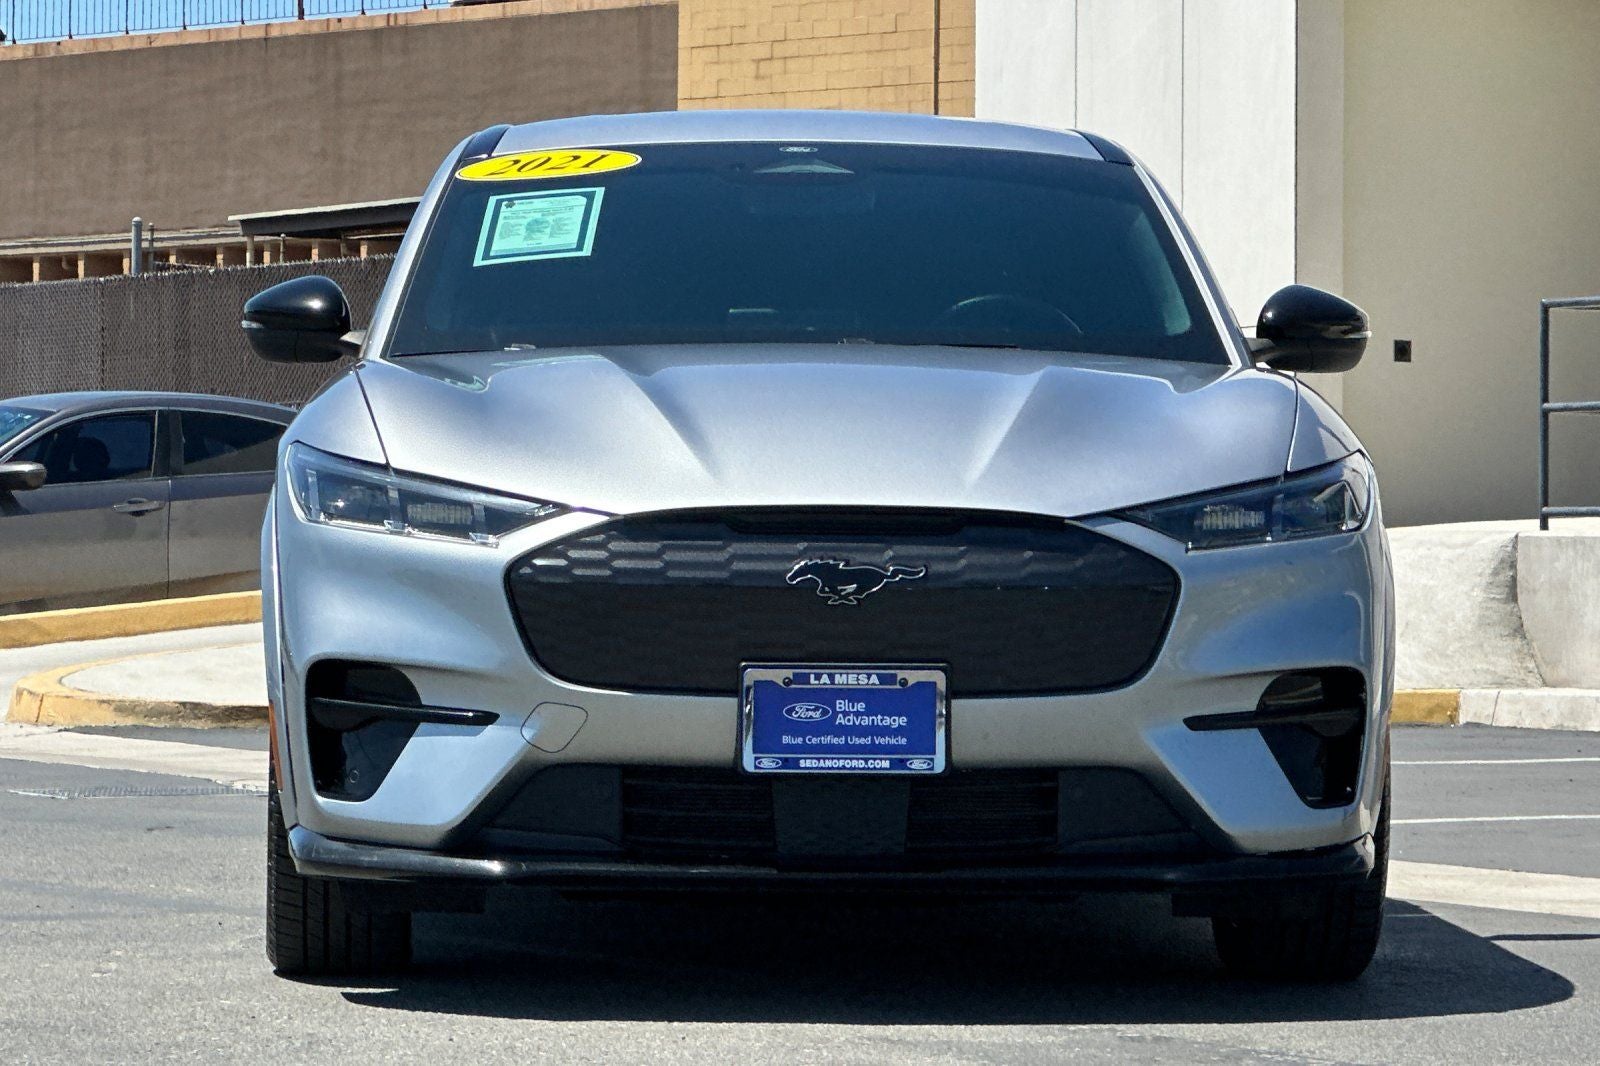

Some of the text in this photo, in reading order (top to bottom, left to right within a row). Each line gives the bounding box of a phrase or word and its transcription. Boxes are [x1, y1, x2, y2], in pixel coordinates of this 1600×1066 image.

[483, 154, 609, 176] 2021
[810, 674, 880, 685] LA MESA
[791, 705, 822, 719] Ford
[836, 700, 866, 712] Blue
[836, 714, 907, 728] Advantage
[782, 735, 907, 745] Blue Certified Used Vehicle
[799, 759, 890, 768] SEDANOFORD.COM
